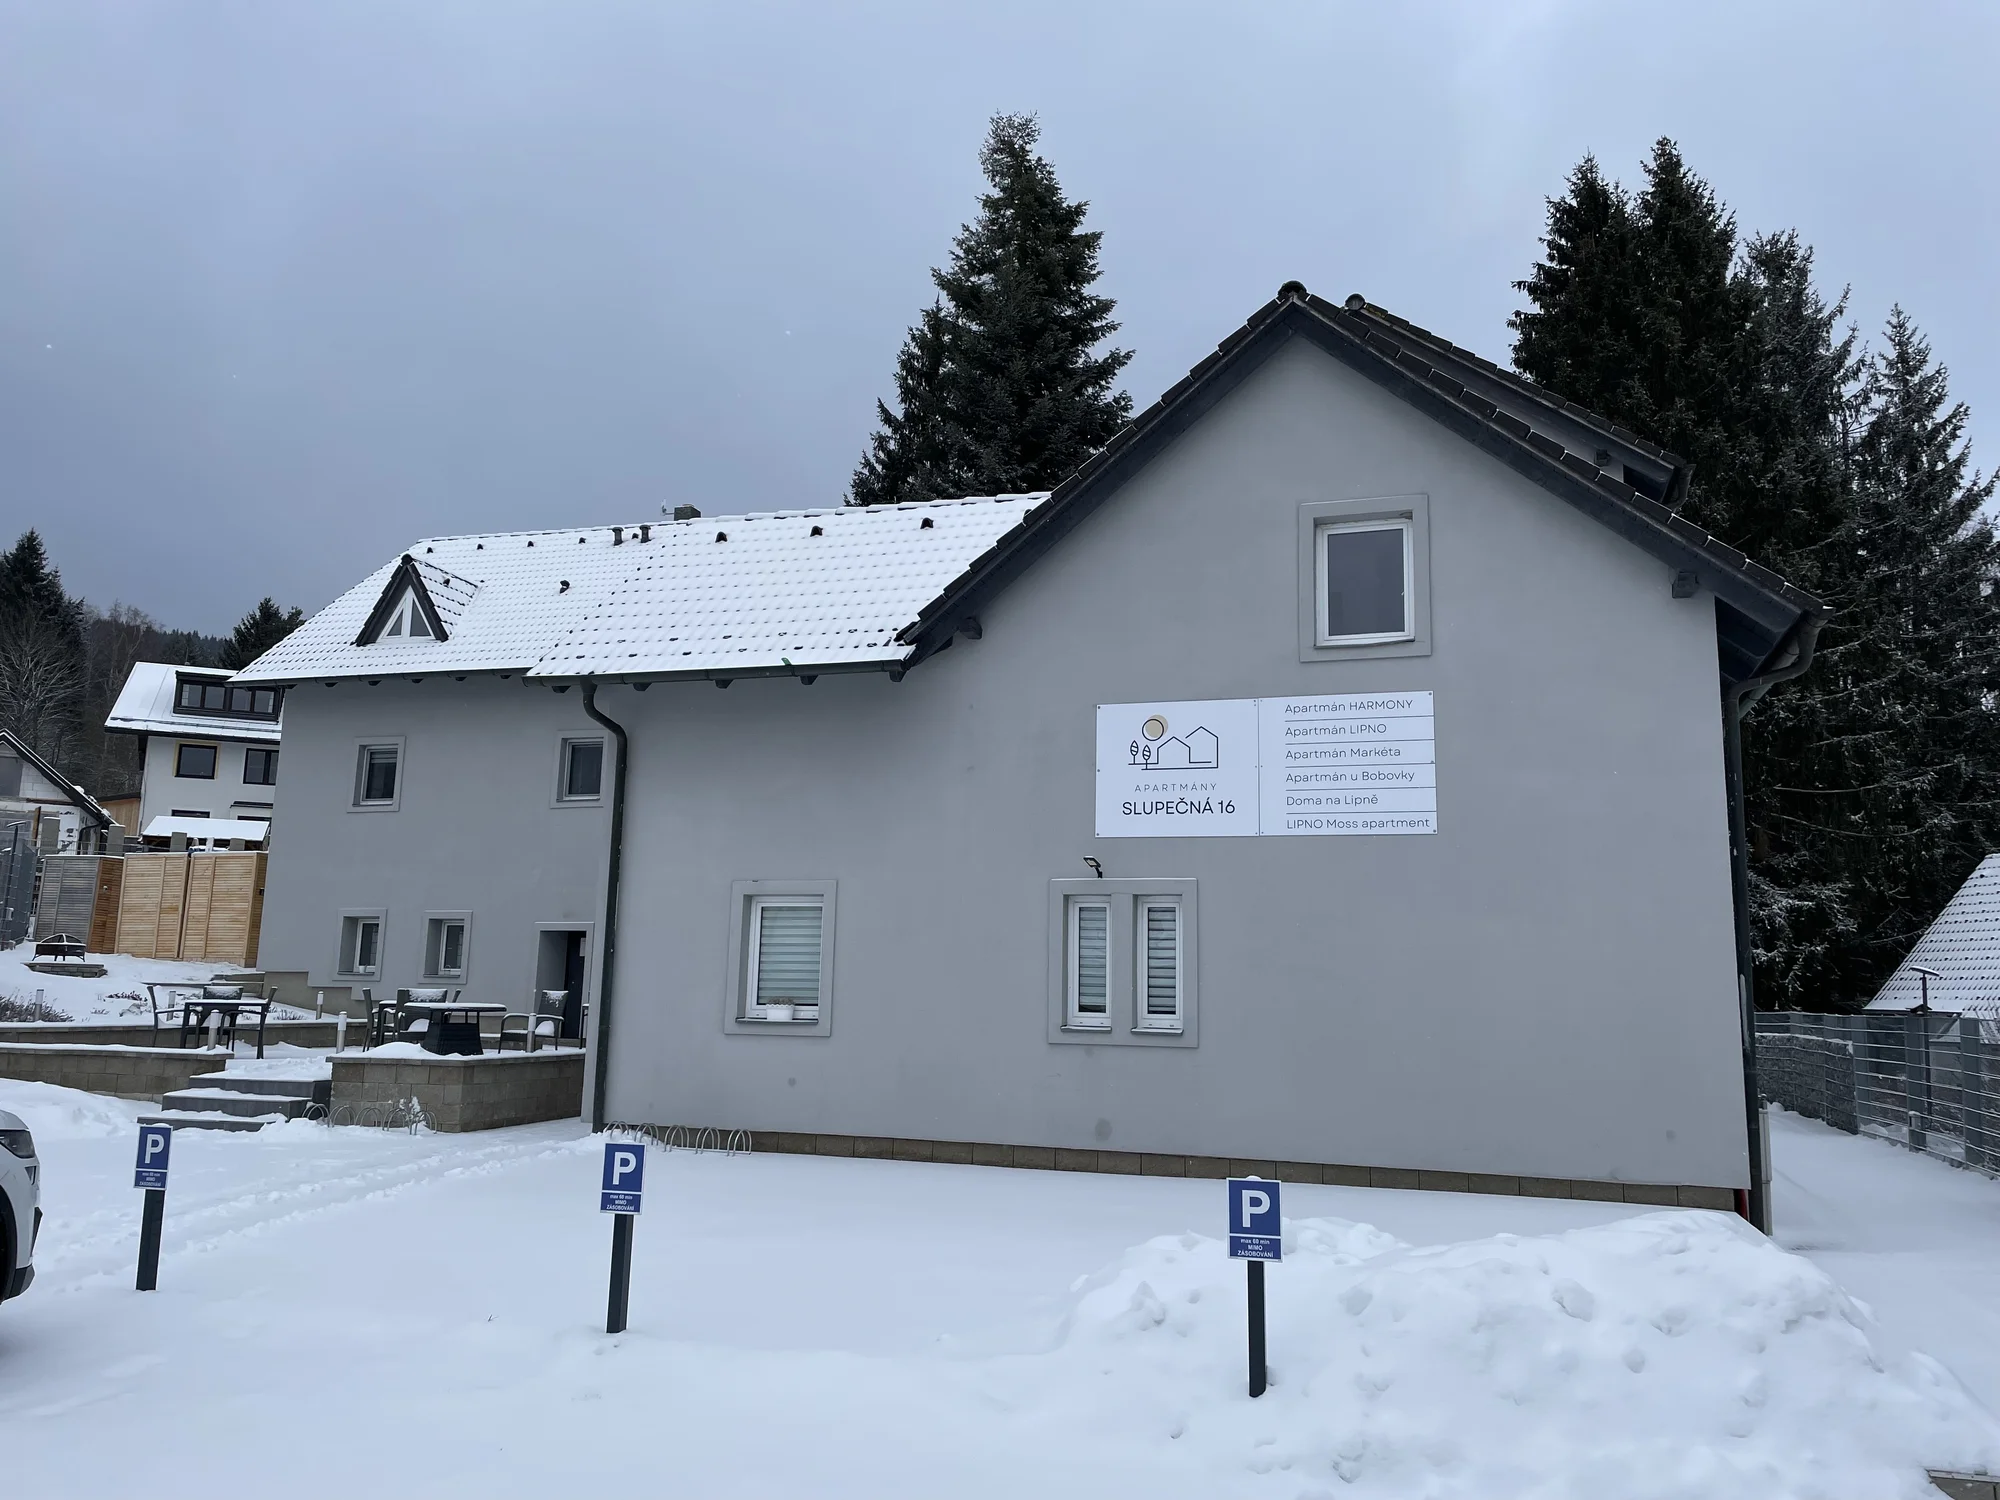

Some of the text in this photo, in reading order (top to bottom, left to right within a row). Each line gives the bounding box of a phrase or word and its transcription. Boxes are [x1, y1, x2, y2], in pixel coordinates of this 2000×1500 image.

[1285, 700, 1413, 716] Apartmán HARMONY
[1285, 724, 1387, 738] Apartmán LIPNO
[1285, 747, 1401, 761] Apartmán Markéta
[1285, 770, 1415, 785] Apartmán u Bobovky
[1134, 781, 1217, 793] APARTMÁNY
[1122, 797, 1236, 815] SLUPEČNÁ 16
[1286, 794, 1379, 807] Doma na Lipně
[1287, 818, 1430, 831] LIPNO Moss apartment
[144, 1134, 165, 1164] P
[613, 1152, 636, 1184] P
[1242, 1190, 1270, 1227] P
